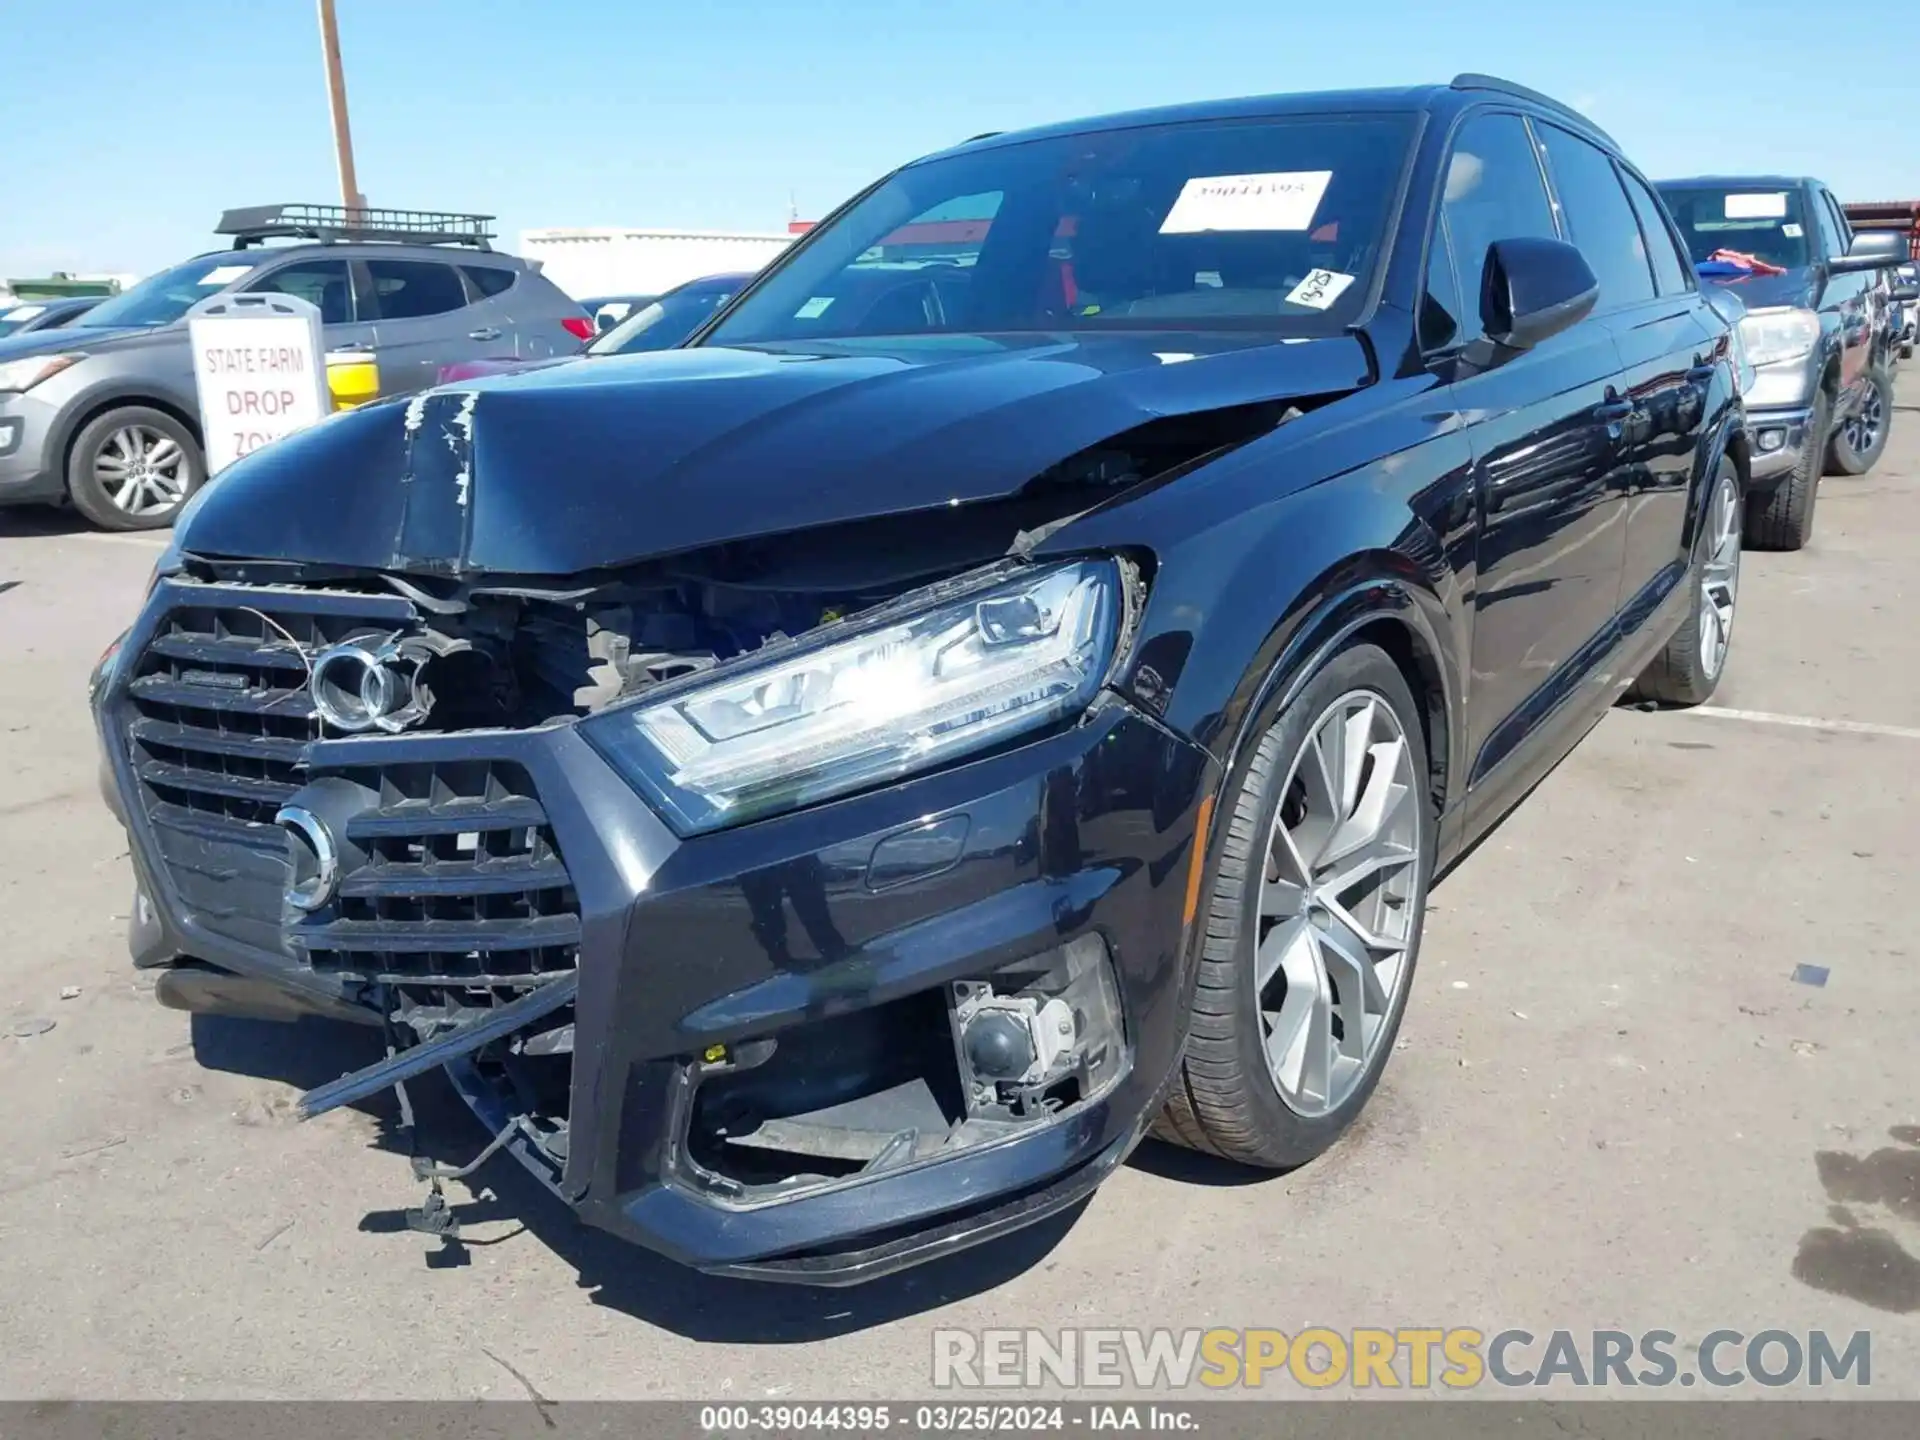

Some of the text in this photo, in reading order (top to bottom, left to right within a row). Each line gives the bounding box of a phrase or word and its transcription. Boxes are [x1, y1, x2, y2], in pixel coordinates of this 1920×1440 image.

[206, 348, 304, 373] STATE FARM
[227, 391, 295, 416] DROP
